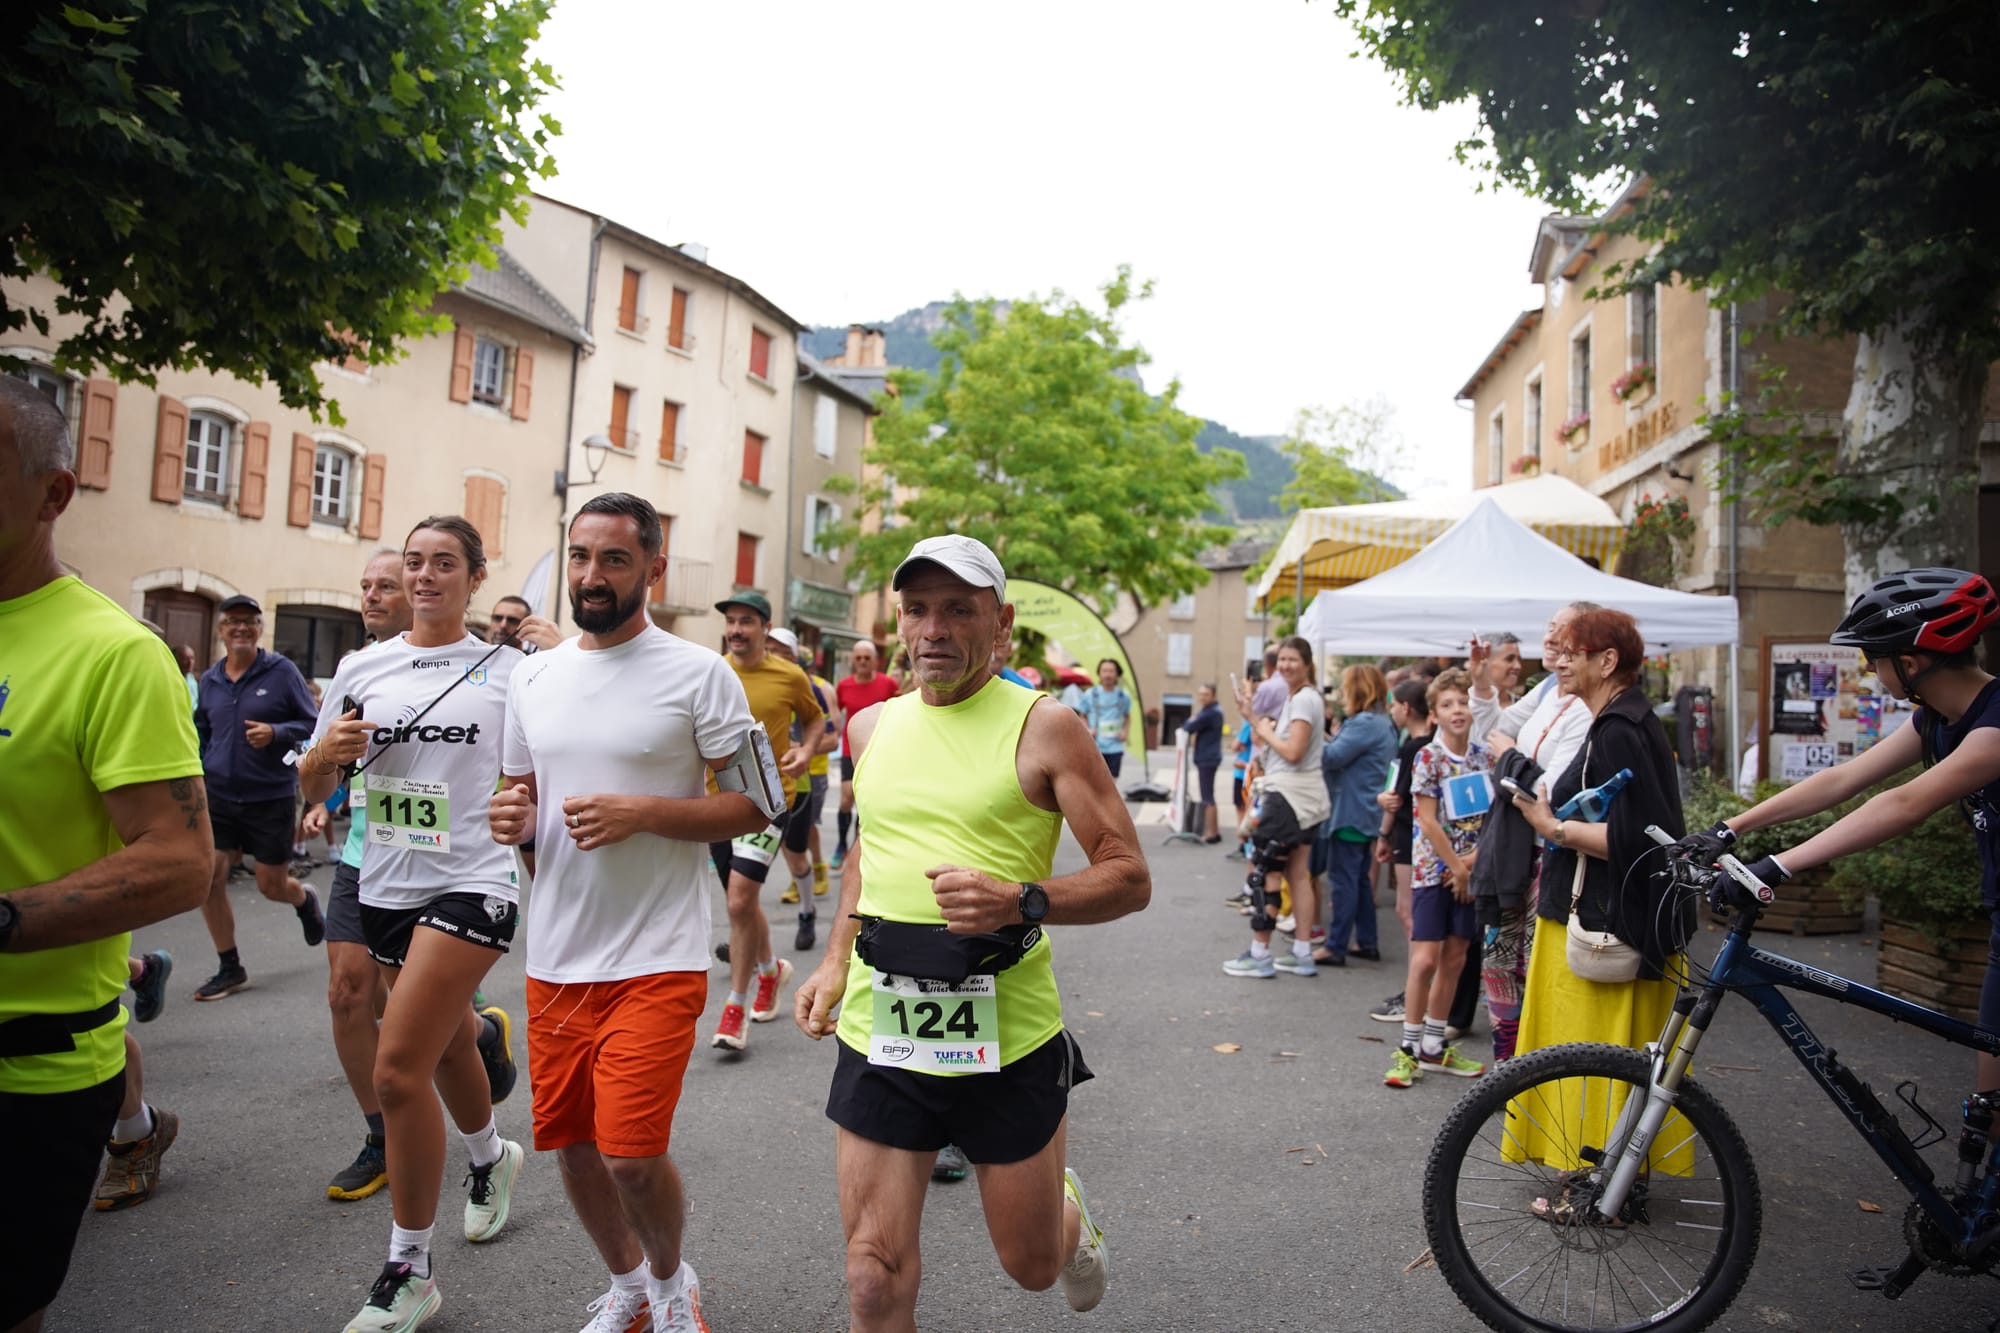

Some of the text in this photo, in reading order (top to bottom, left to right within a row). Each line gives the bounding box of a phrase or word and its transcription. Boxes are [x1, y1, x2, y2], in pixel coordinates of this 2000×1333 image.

[412, 659, 450, 670] Kempa
[372, 717, 480, 746] circet
[1807, 747, 1833, 764] 05
[1465, 785, 1476, 804] 1
[379, 794, 437, 828] 113
[431, 916, 459, 932] Kempa
[466, 928, 492, 943] Kempa
[890, 999, 979, 1039] 124
[883, 1045, 910, 1054] BFP
[934, 1050, 974, 1059] TUFF'S
